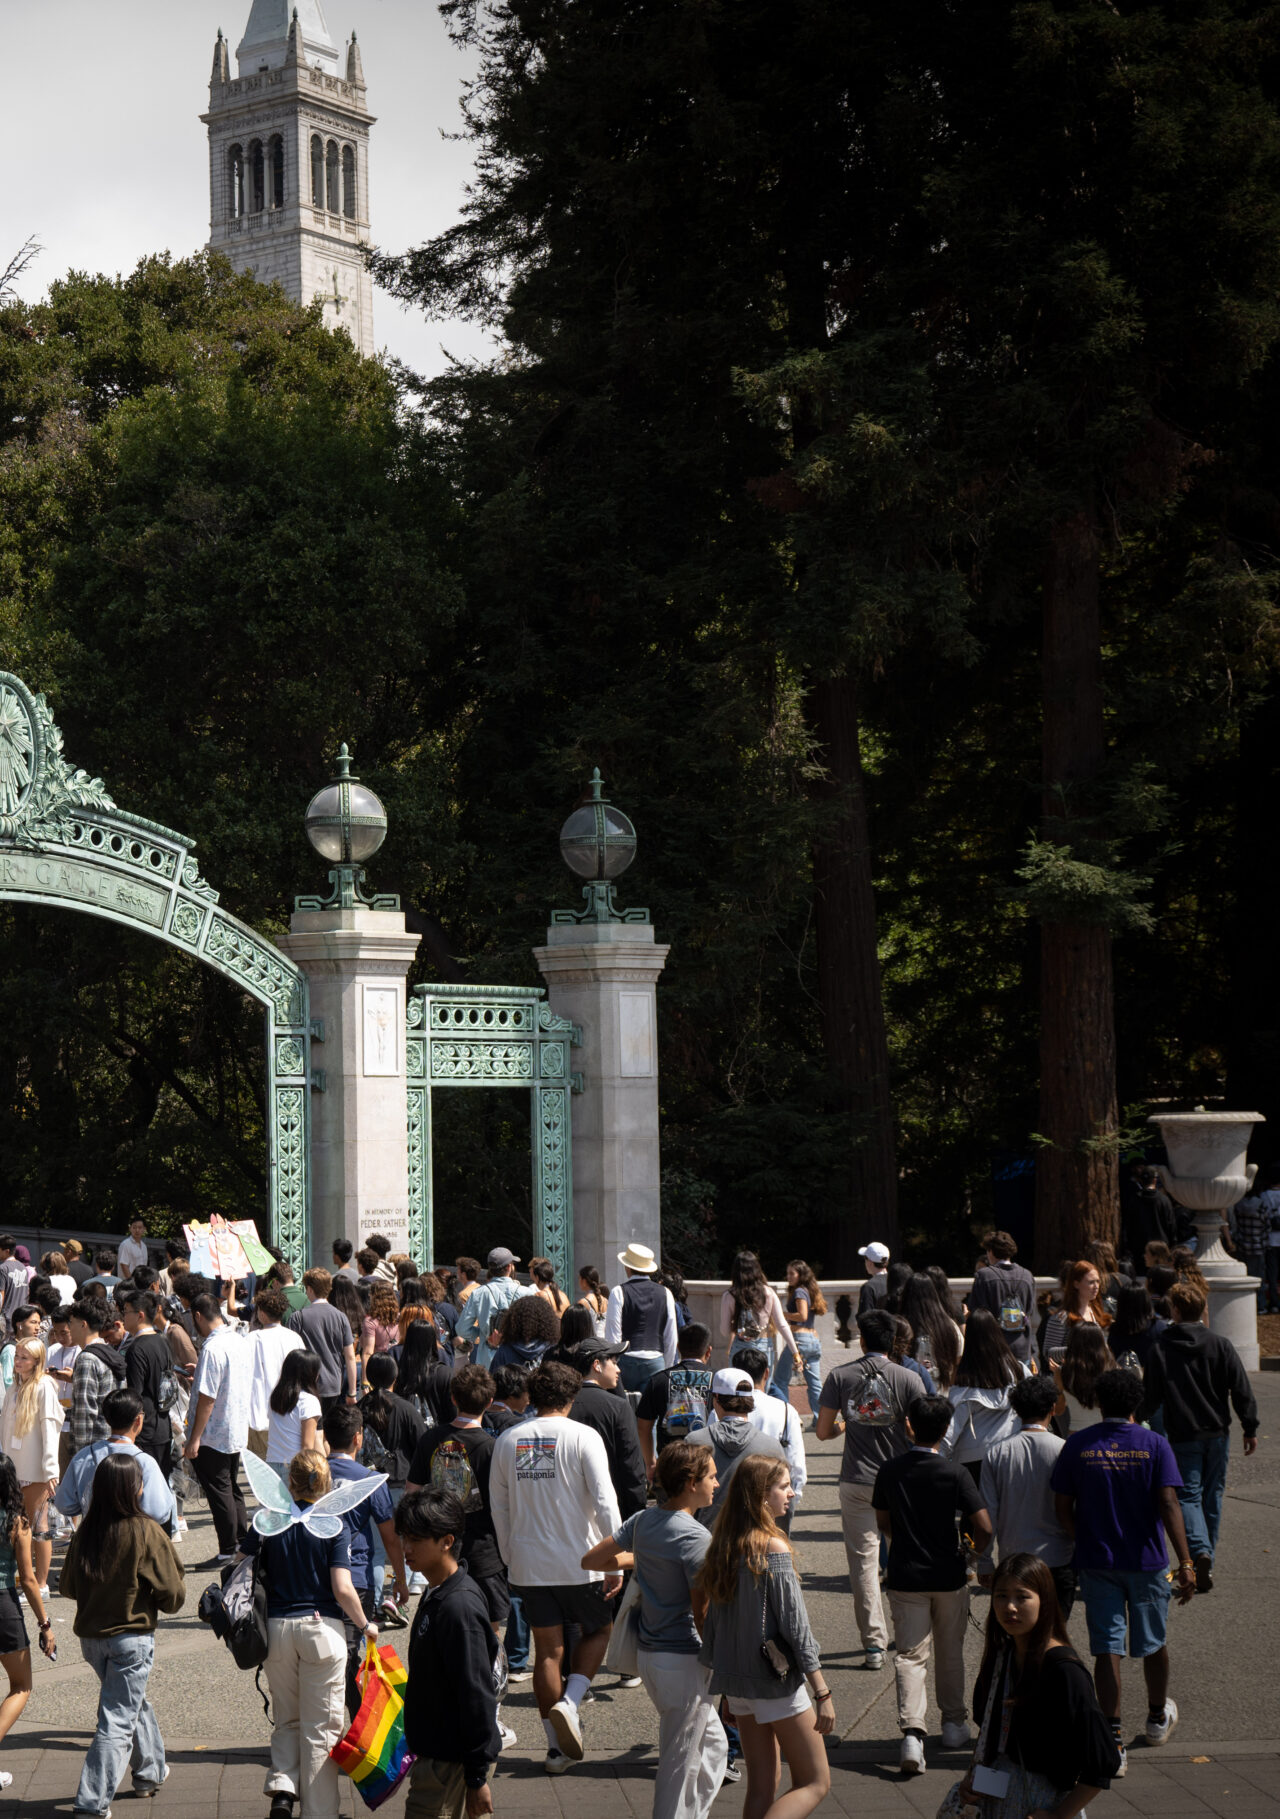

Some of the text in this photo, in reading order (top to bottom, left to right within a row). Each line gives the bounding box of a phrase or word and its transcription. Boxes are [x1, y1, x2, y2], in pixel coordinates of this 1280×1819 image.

[35, 862, 112, 900] GATE
[360, 1218, 406, 1228] PEDER SATHER
[1105, 1450, 1150, 1459] SHORTIES
[516, 1470, 556, 1481] patagonia
